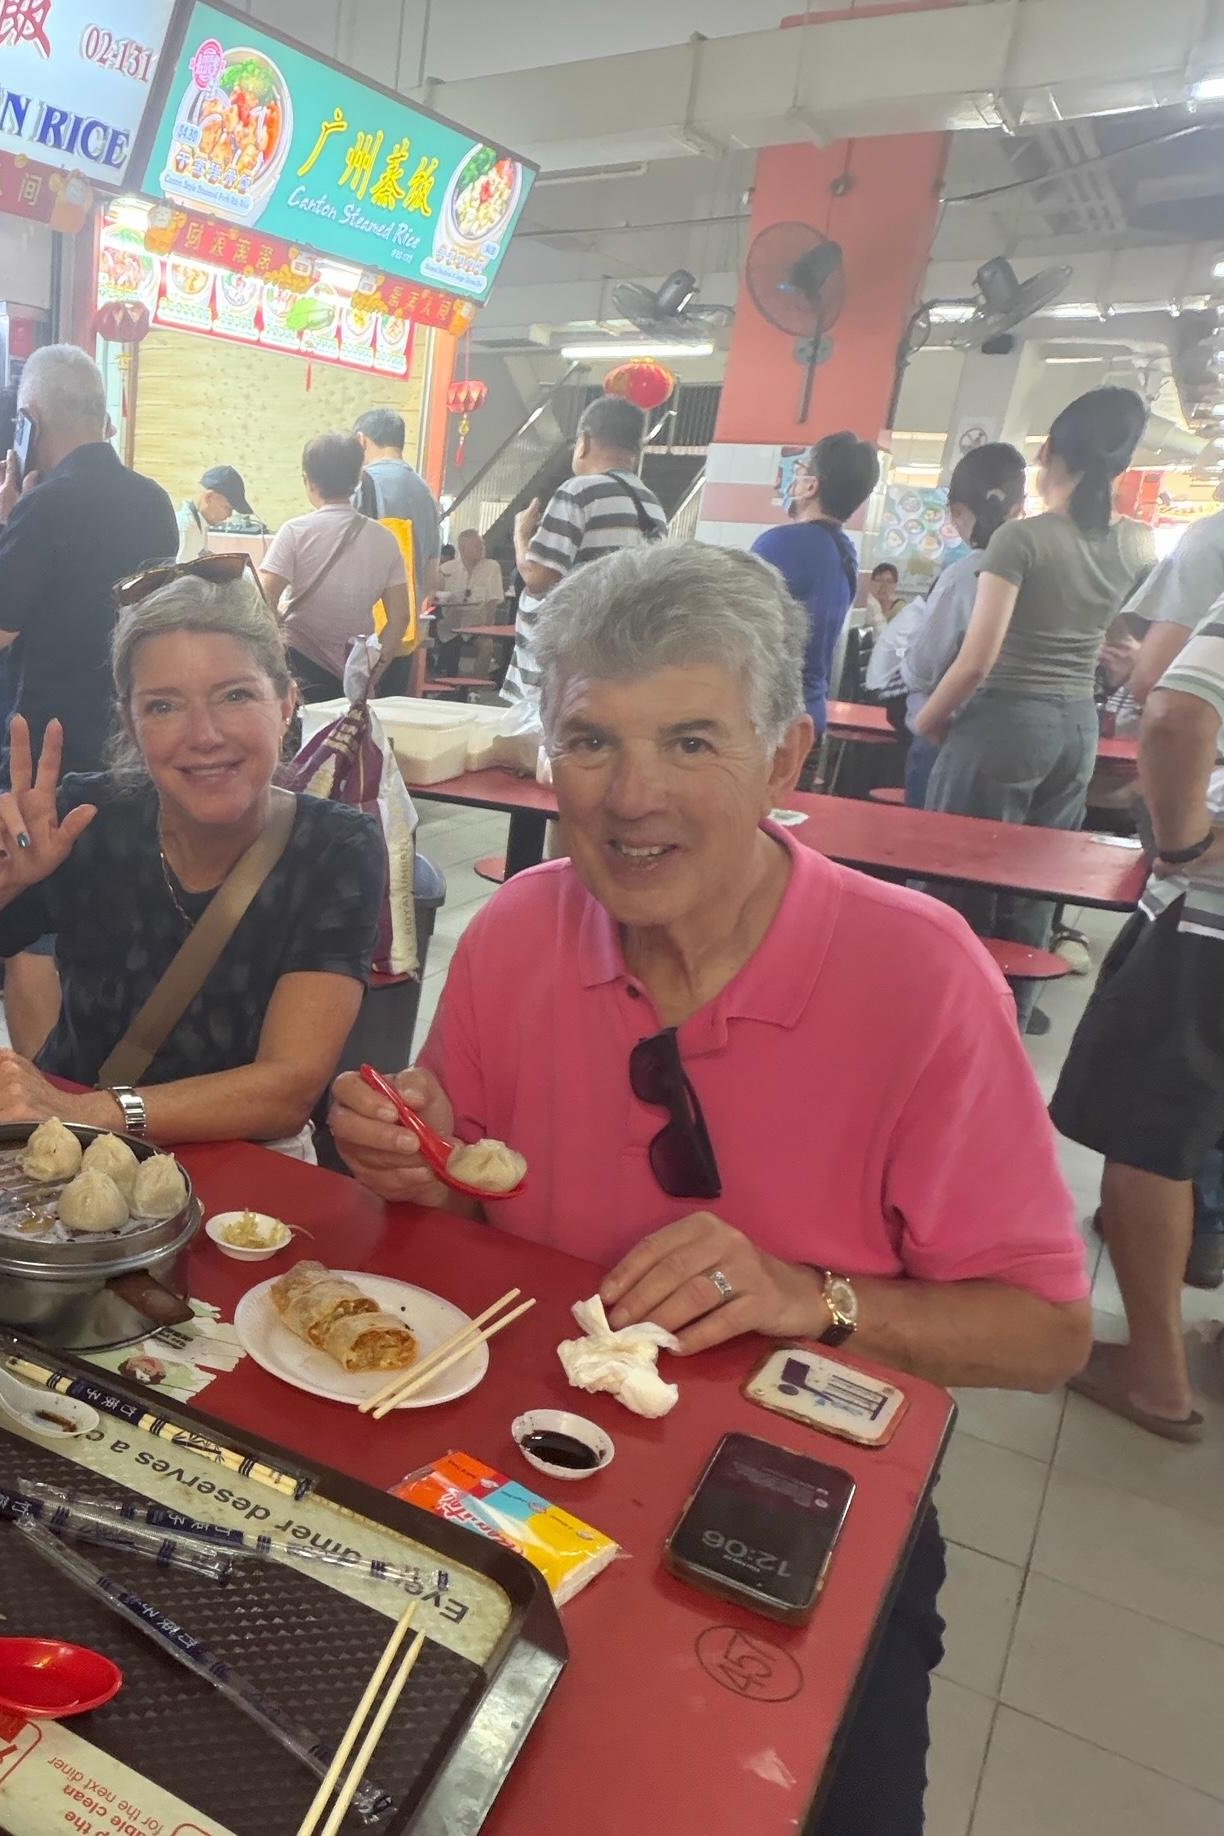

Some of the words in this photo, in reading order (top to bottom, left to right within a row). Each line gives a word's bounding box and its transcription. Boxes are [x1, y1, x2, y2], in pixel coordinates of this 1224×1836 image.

[84, 24, 152, 83] 02-131
[39, 104, 130, 168] RICE
[287, 185, 338, 220] Canton
[339, 203, 396, 240] Steamed
[393, 222, 422, 249] Rice
[110, 1440, 130, 1453] a
[134, 1450, 271, 1521] deserves
[702, 1530, 791, 1577] 12:06
[718, 1630, 777, 1693] 457
[47, 1757, 84, 1782] diner
[63, 1784, 107, 1816] clean
[83, 1779, 117, 1803] next
[64, 1811, 92, 1835] the
[117, 1800, 141, 1821] the
[141, 1816, 164, 1836] for
